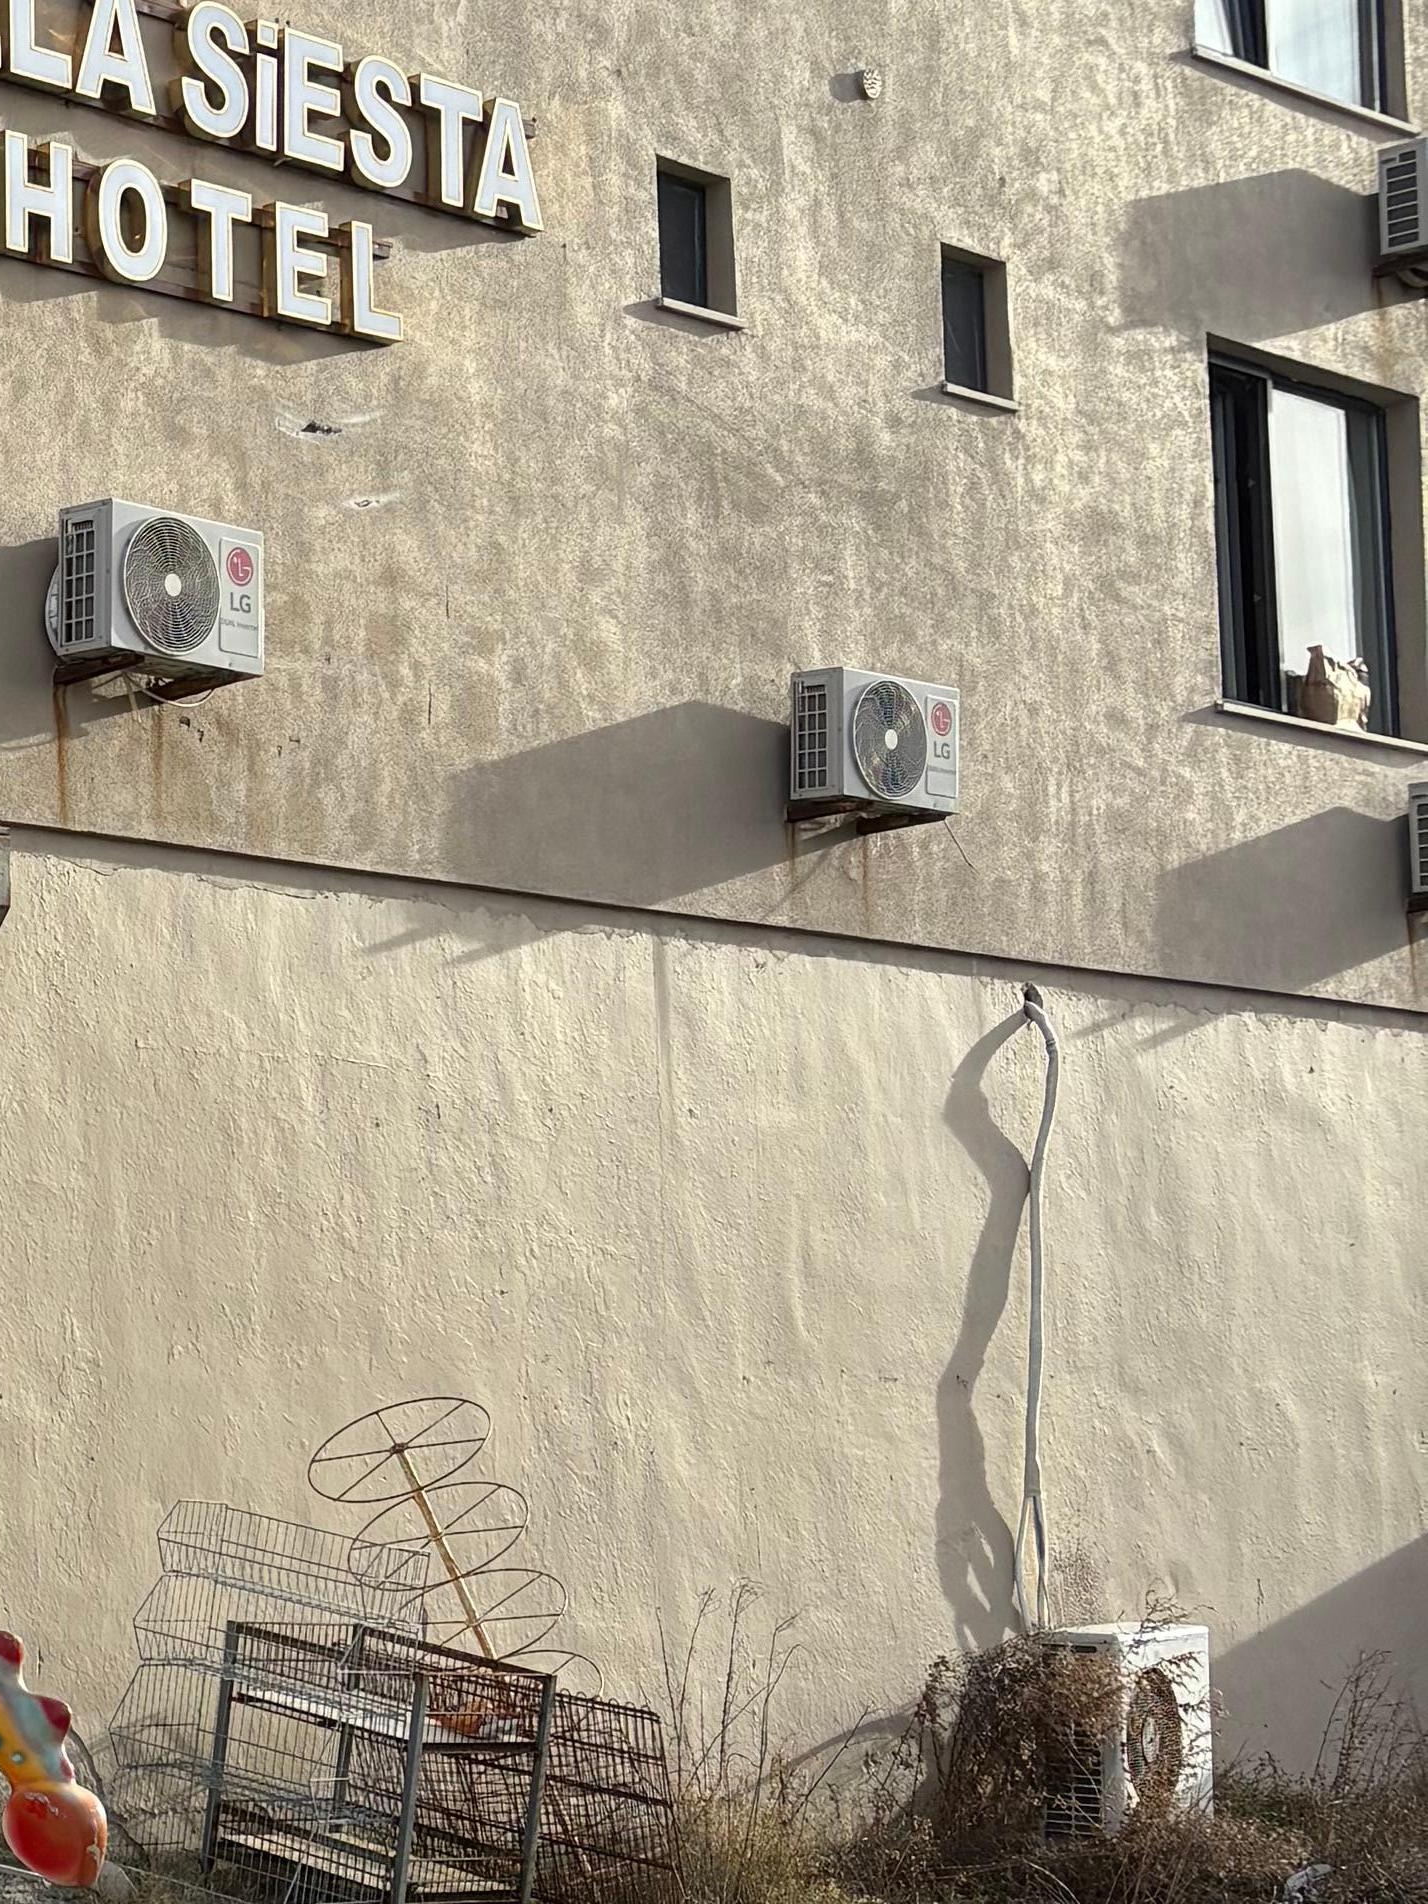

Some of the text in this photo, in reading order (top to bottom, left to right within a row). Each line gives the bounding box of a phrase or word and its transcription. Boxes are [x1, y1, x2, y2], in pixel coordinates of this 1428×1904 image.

[1, 129, 405, 343] HOTEL
[230, 592, 252, 614] LG
[933, 741, 951, 760] LG
